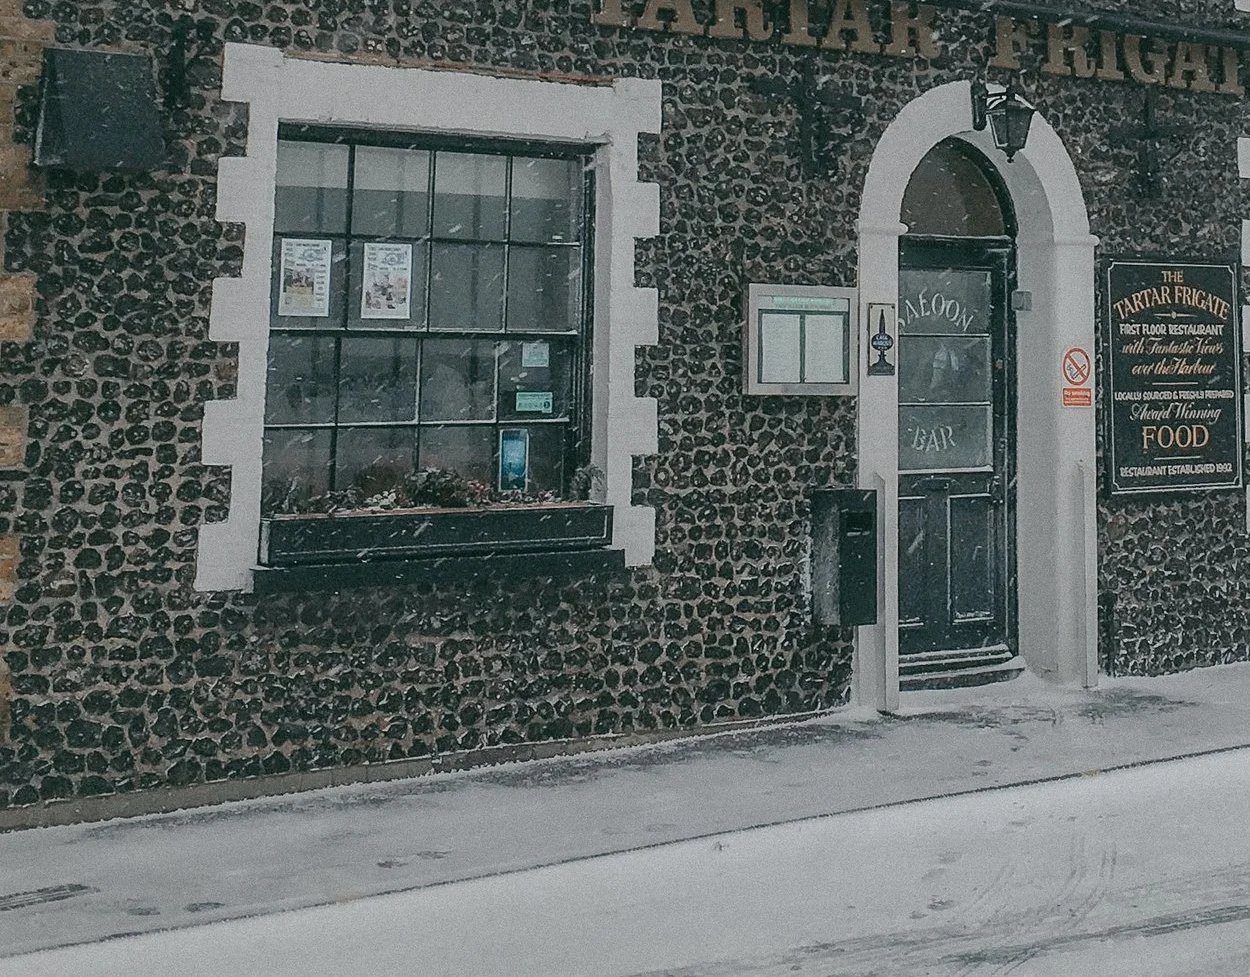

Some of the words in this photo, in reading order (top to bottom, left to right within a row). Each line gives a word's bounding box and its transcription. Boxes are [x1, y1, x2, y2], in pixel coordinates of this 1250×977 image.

[1161, 270, 1184, 283] THE
[1113, 285, 1172, 320] TARTAR
[1173, 285, 1231, 320] FRIGATE
[1119, 323, 1141, 335] FIRST
[1142, 324, 1167, 335] FLOOR
[1168, 324, 1224, 336] RESTAURANT
[1122, 337, 1145, 354] with
[1145, 337, 1194, 355] Fantastic
[1195, 336, 1224, 354] Views
[1131, 362, 1154, 375] over
[1154, 357, 1171, 375] the
[1169, 356, 1217, 375] Harbour
[1114, 391, 1142, 401] LOCALLY
[1143, 391, 1172, 401] SOURCED
[1129, 402, 1173, 421] Award
[1170, 401, 1222, 425] Winning
[911, 425, 956, 452] BAR
[1142, 424, 1209, 450] FOOD
[1119, 465, 1167, 477] RESTAURANT
[1167, 463, 1215, 475] ESTABLISHED
